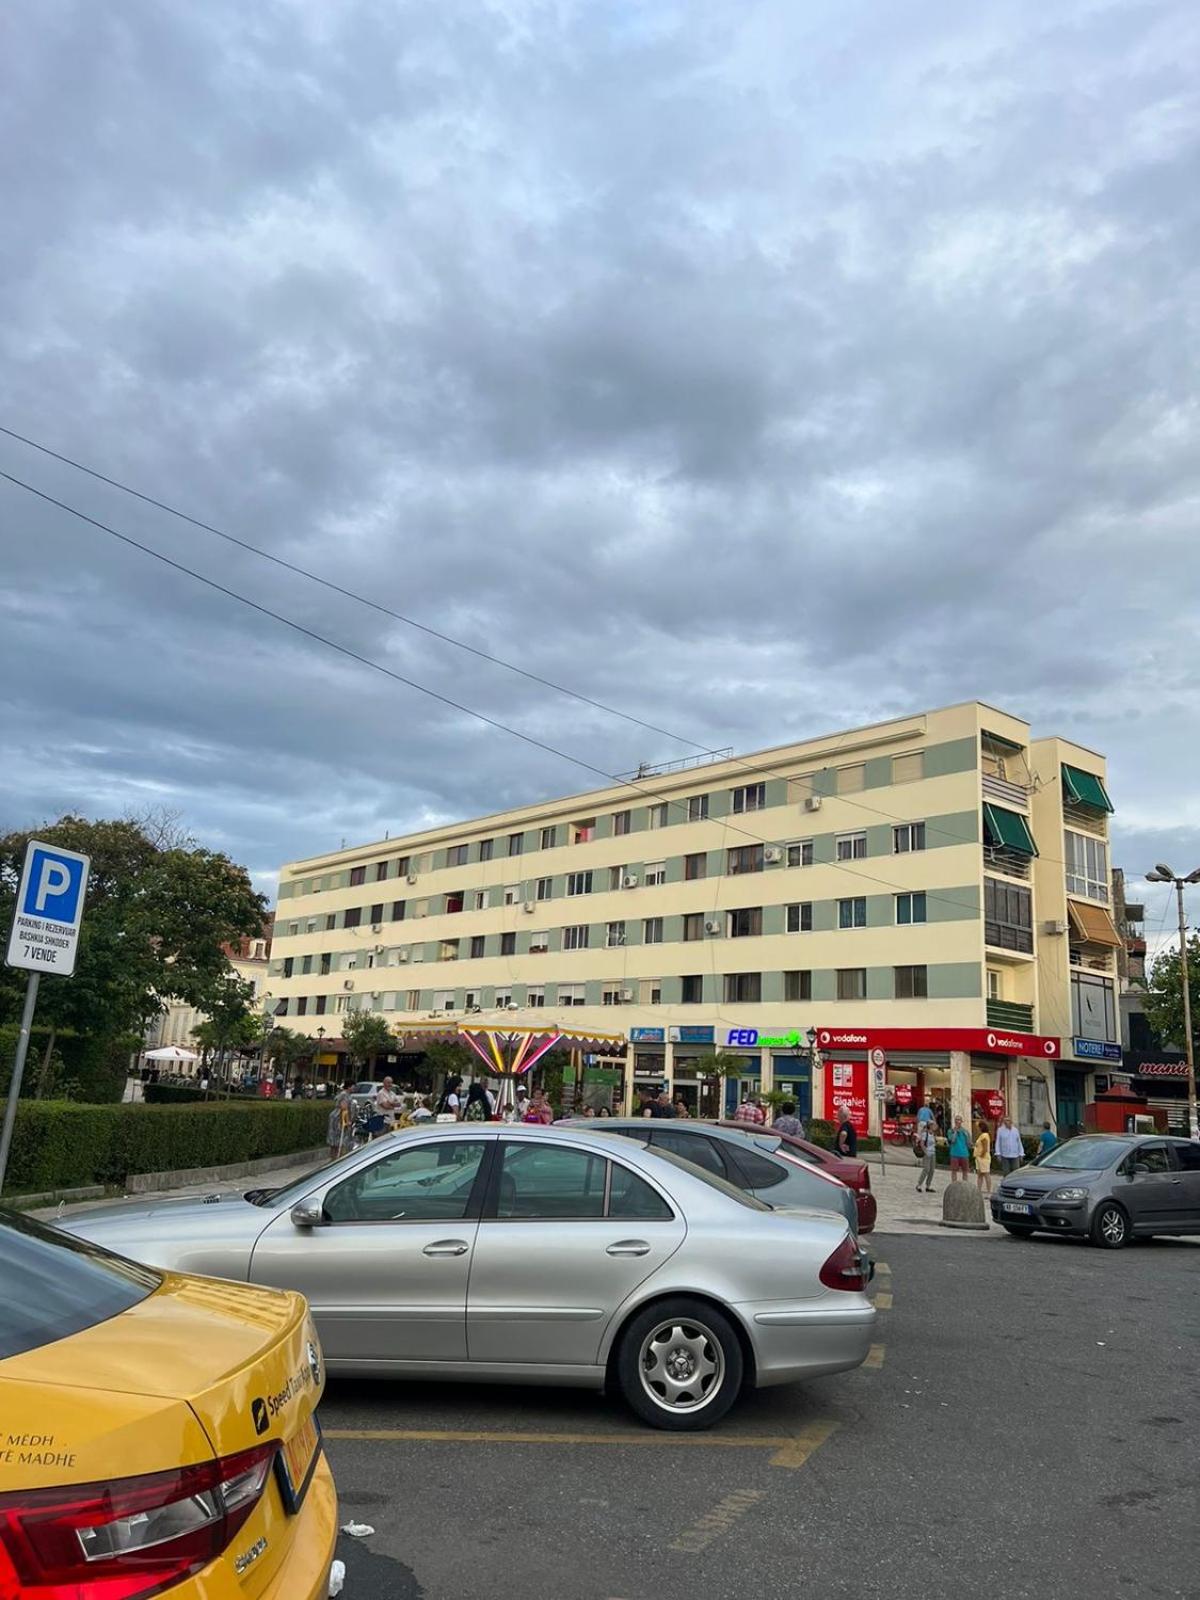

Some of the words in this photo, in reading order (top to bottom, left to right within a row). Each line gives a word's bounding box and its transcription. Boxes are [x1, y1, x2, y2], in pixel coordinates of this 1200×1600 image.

[35, 858, 71, 911] P
[17, 917, 41, 930] PARKING
[24, 945, 30, 958] 7
[31, 946, 57, 963] VENDE
[728, 1030, 758, 1045] FED
[833, 1034, 867, 1043] vodafone
[996, 1038, 1023, 1049] vodafone
[833, 1096, 866, 1108] GigaNet
[268, 1380, 291, 1416] Speed
[18, 1452, 77, 1467] MADHE
